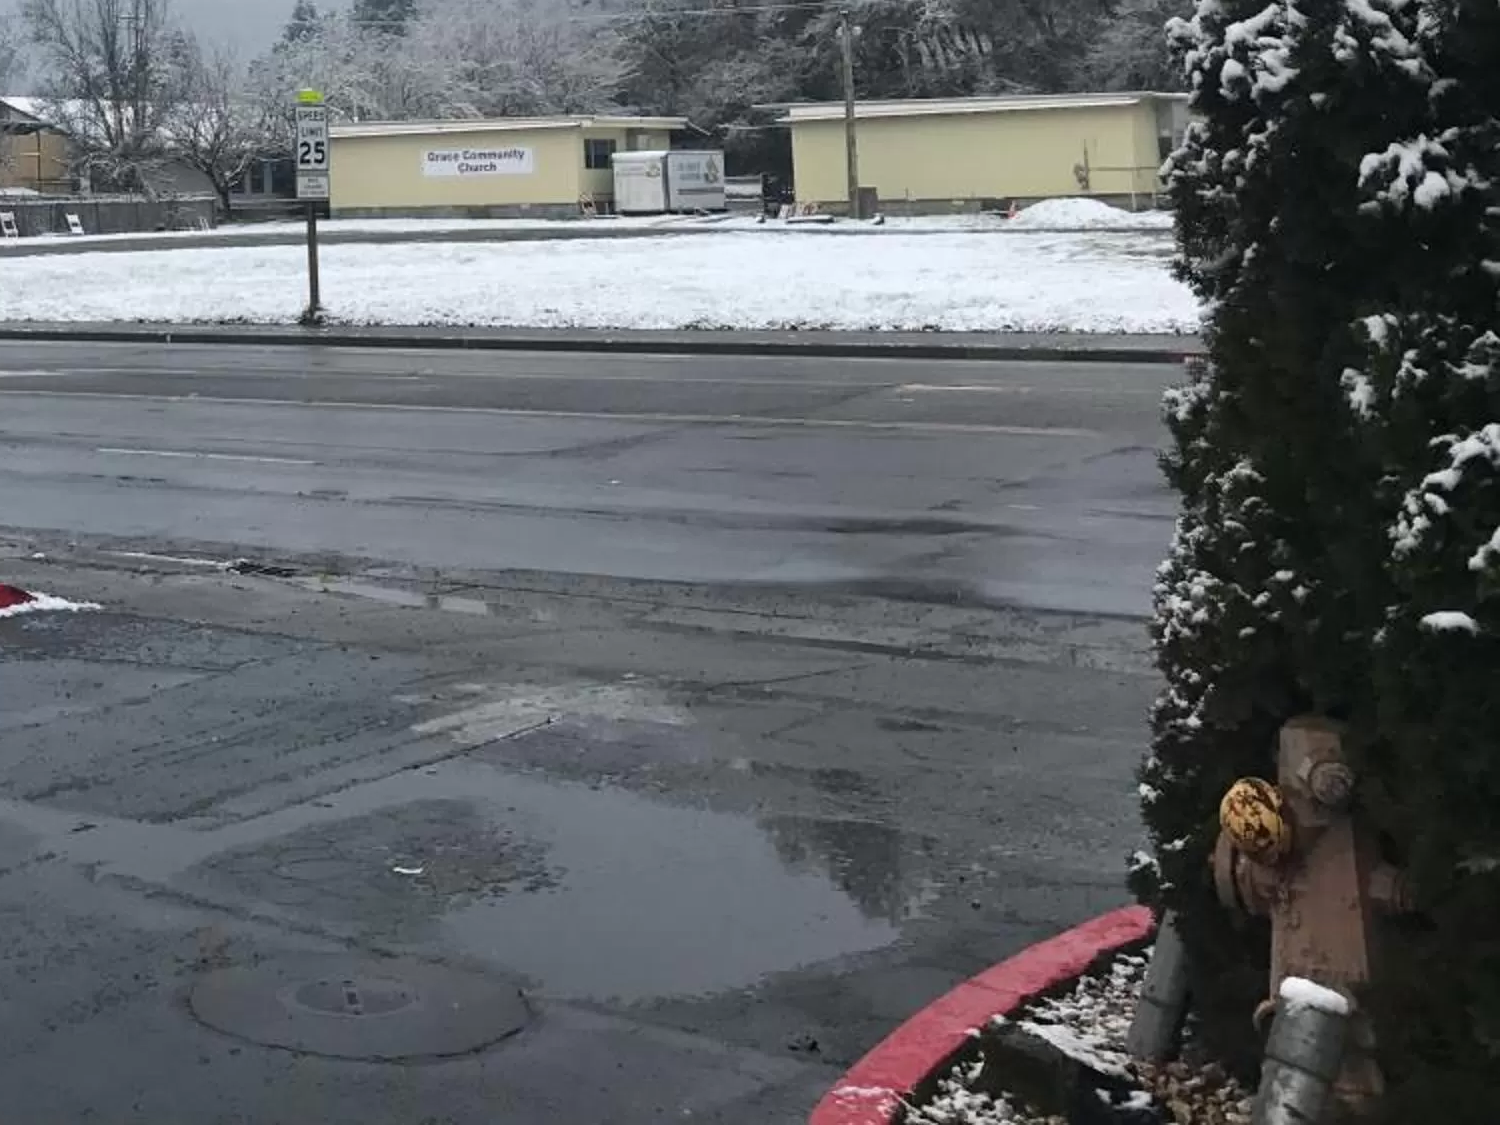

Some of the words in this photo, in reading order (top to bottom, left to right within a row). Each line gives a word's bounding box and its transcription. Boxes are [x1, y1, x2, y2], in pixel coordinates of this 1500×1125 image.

[298, 110, 325, 121] SPEED
[301, 126, 322, 137] LIMIT
[299, 141, 325, 164] 25
[427, 152, 459, 162] Grace
[462, 149, 525, 160] Community
[457, 162, 497, 173] Church
